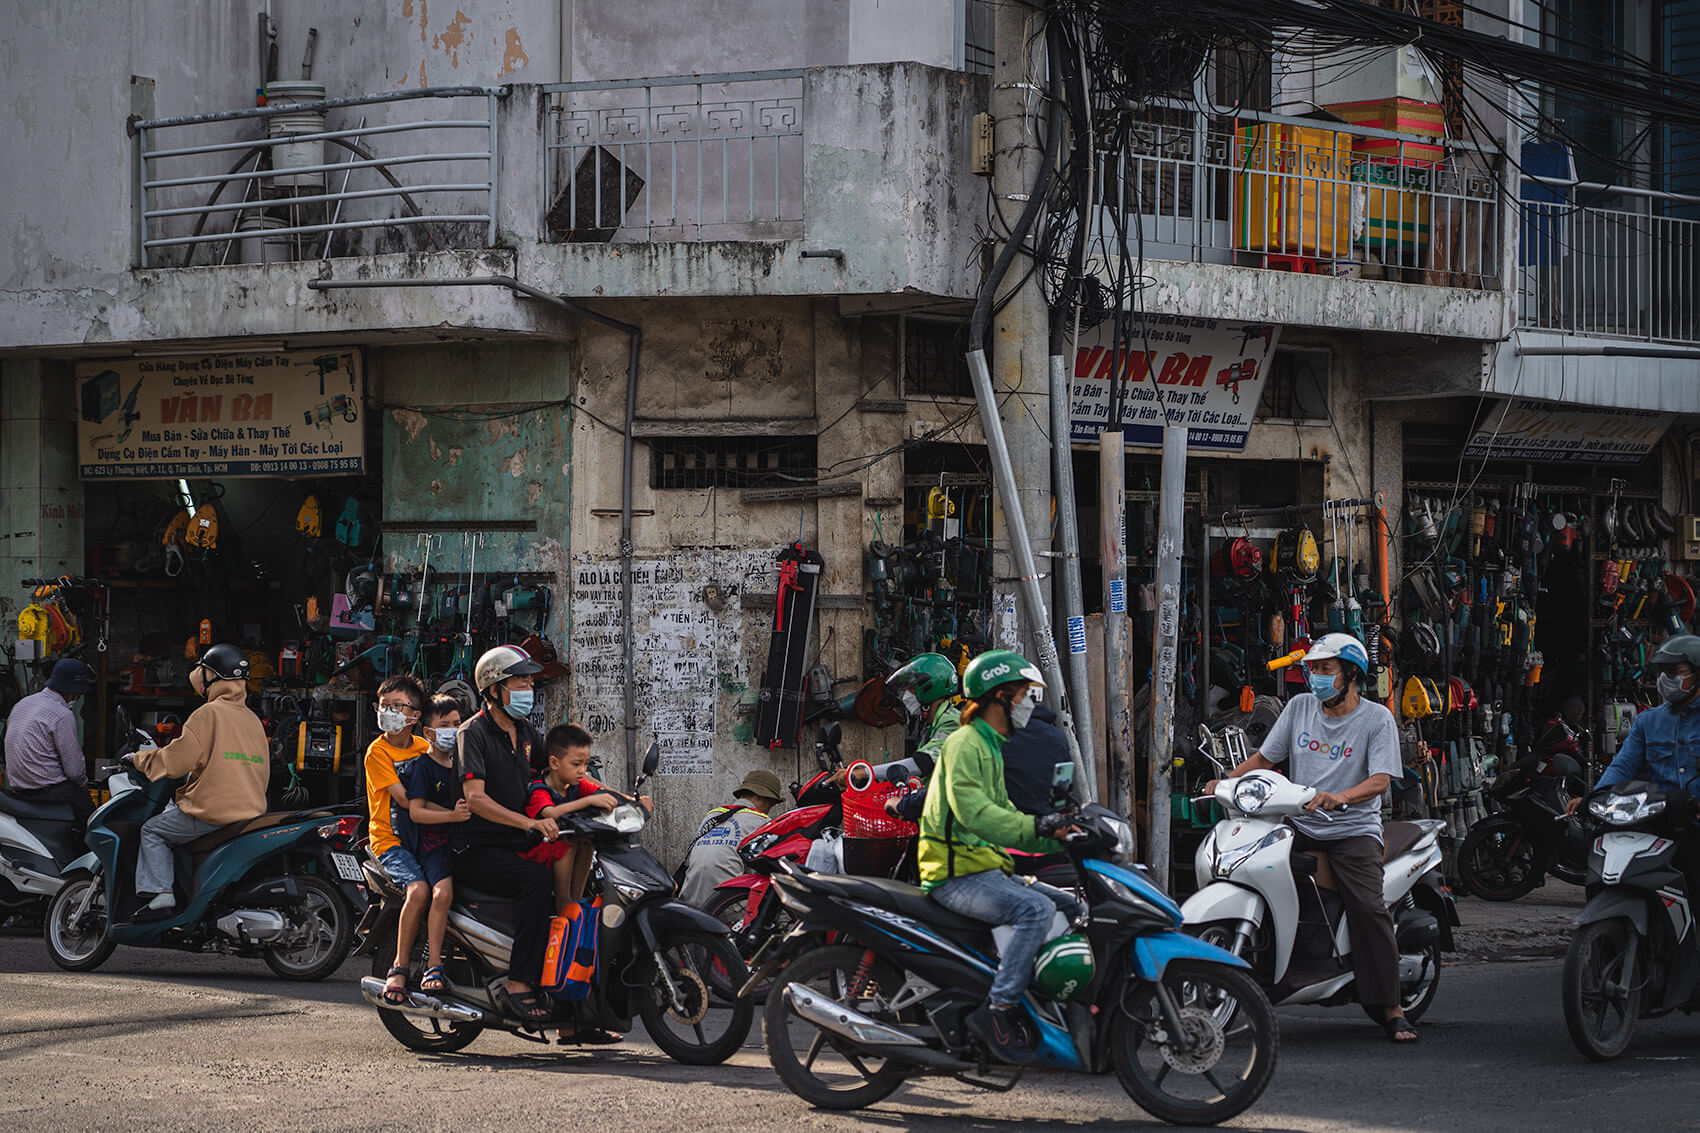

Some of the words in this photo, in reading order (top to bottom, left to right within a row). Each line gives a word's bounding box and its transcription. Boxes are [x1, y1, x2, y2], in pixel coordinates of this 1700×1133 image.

[274, 356, 289, 368] Tay
[1157, 352, 1214, 387] BA
[1083, 384, 1102, 398] Bán
[1167, 391, 1188, 405] Thay
[1190, 390, 1209, 405] Thế
[160, 391, 223, 424] VĂN
[232, 392, 273, 422] BA
[1095, 403, 1109, 417] Tay
[1203, 410, 1219, 423] Các
[142, 430, 161, 442] Mua
[164, 430, 181, 441] Bán
[211, 427, 234, 441] Chữa
[237, 427, 244, 439] &
[247, 427, 269, 440] Thay
[272, 424, 292, 439] Thế
[97, 448, 120, 462] Dụng
[123, 447, 135, 461] Cụ
[138, 447, 158, 461] Điện
[183, 446, 200, 459] Tay
[209, 445, 228, 459] Máy
[231, 444, 250, 456] Hàn
[259, 444, 279, 457] Máy
[282, 443, 297, 455] Tời
[300, 442, 318, 454] Các
[321, 440, 343, 456] Loại
[214, 463, 228, 474] HCM
[262, 461, 279, 472] 0913
[280, 461, 288, 471] 14
[289, 461, 297, 471] 00
[299, 461, 307, 470] 13
[312, 460, 329, 470] 0908
[330, 459, 338, 470] 75
[340, 459, 349, 469] 95
[349, 458, 358, 469] 85
[579, 572, 596, 585] ALO
[590, 590, 602, 601] VAY
[586, 636, 598, 647] VAY
[981, 662, 1011, 682] Grab
[1297, 731, 1353, 761] Google
